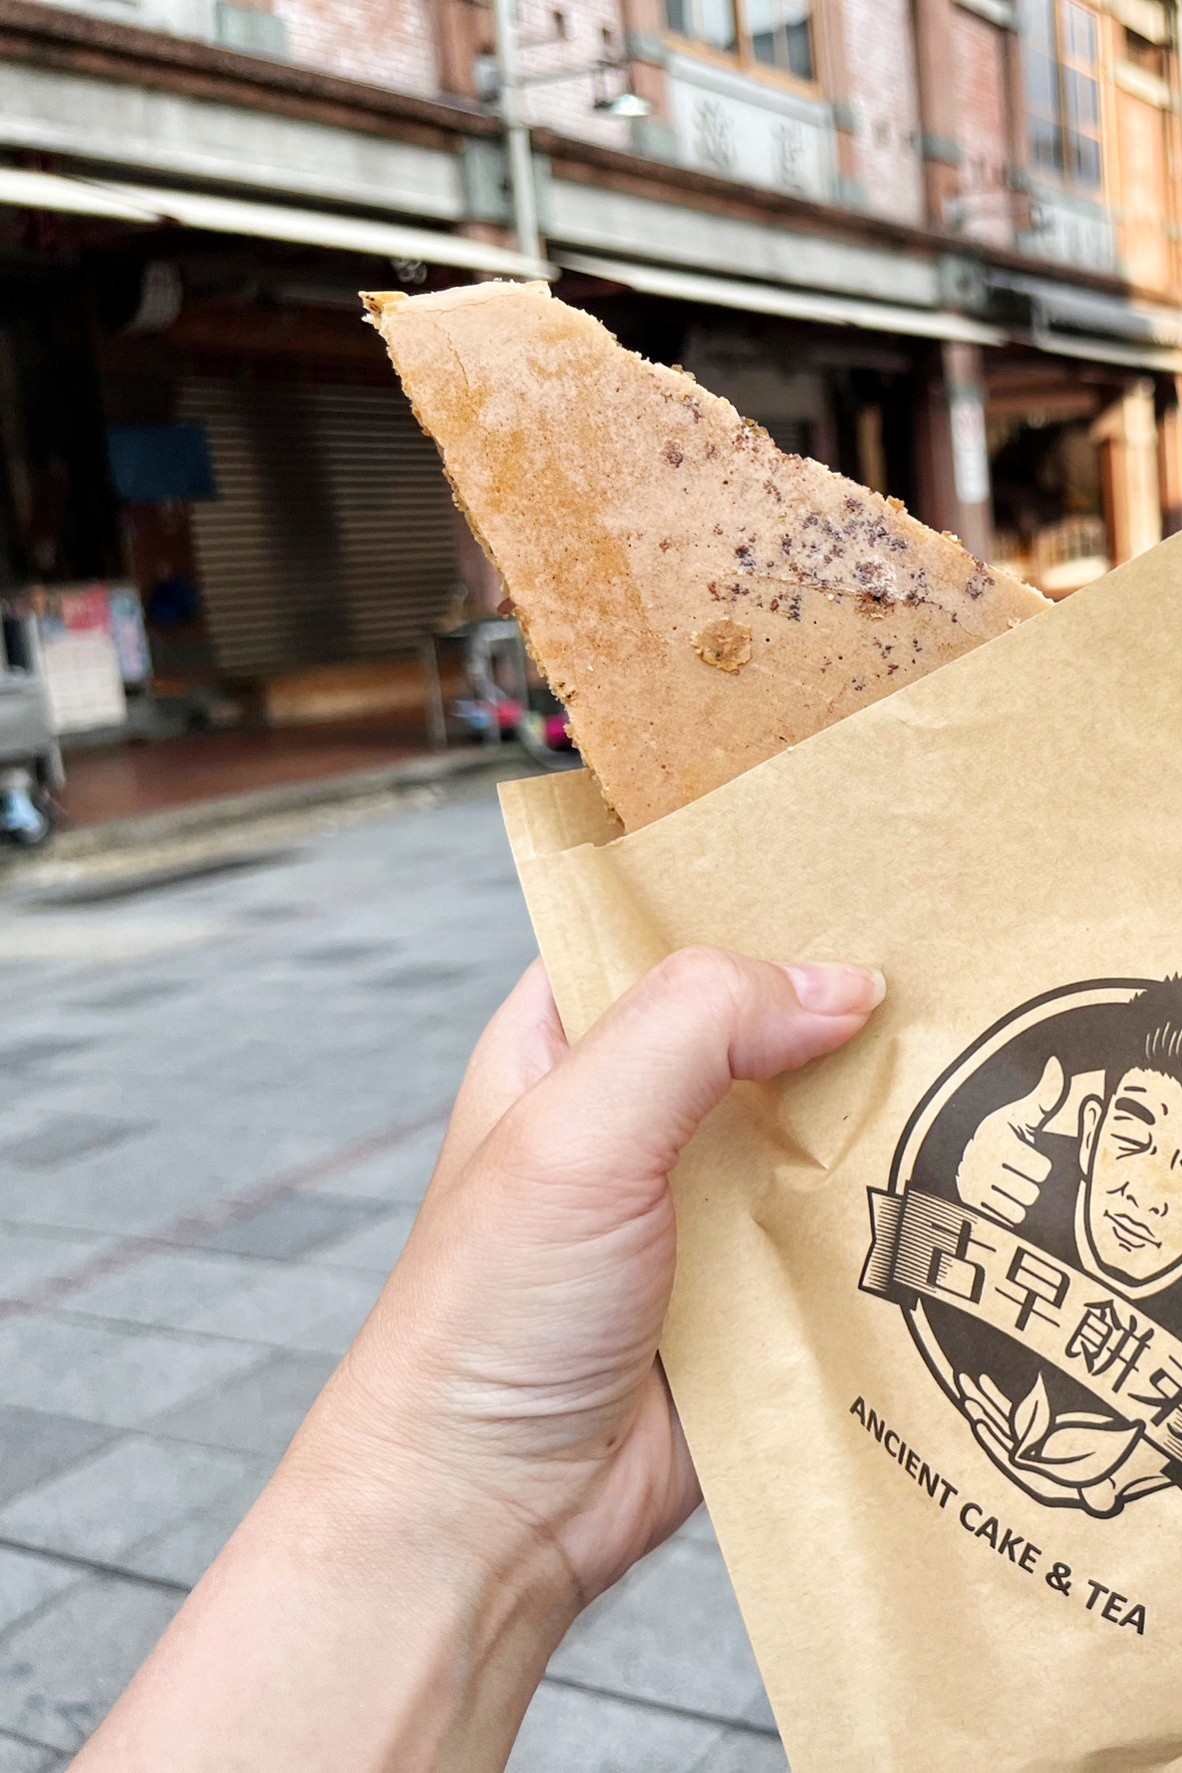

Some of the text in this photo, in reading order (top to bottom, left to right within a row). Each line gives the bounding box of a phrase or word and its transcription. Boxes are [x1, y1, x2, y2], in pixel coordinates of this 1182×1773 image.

[849, 1395, 1147, 1635] ANCIENT CAKE & TEA
